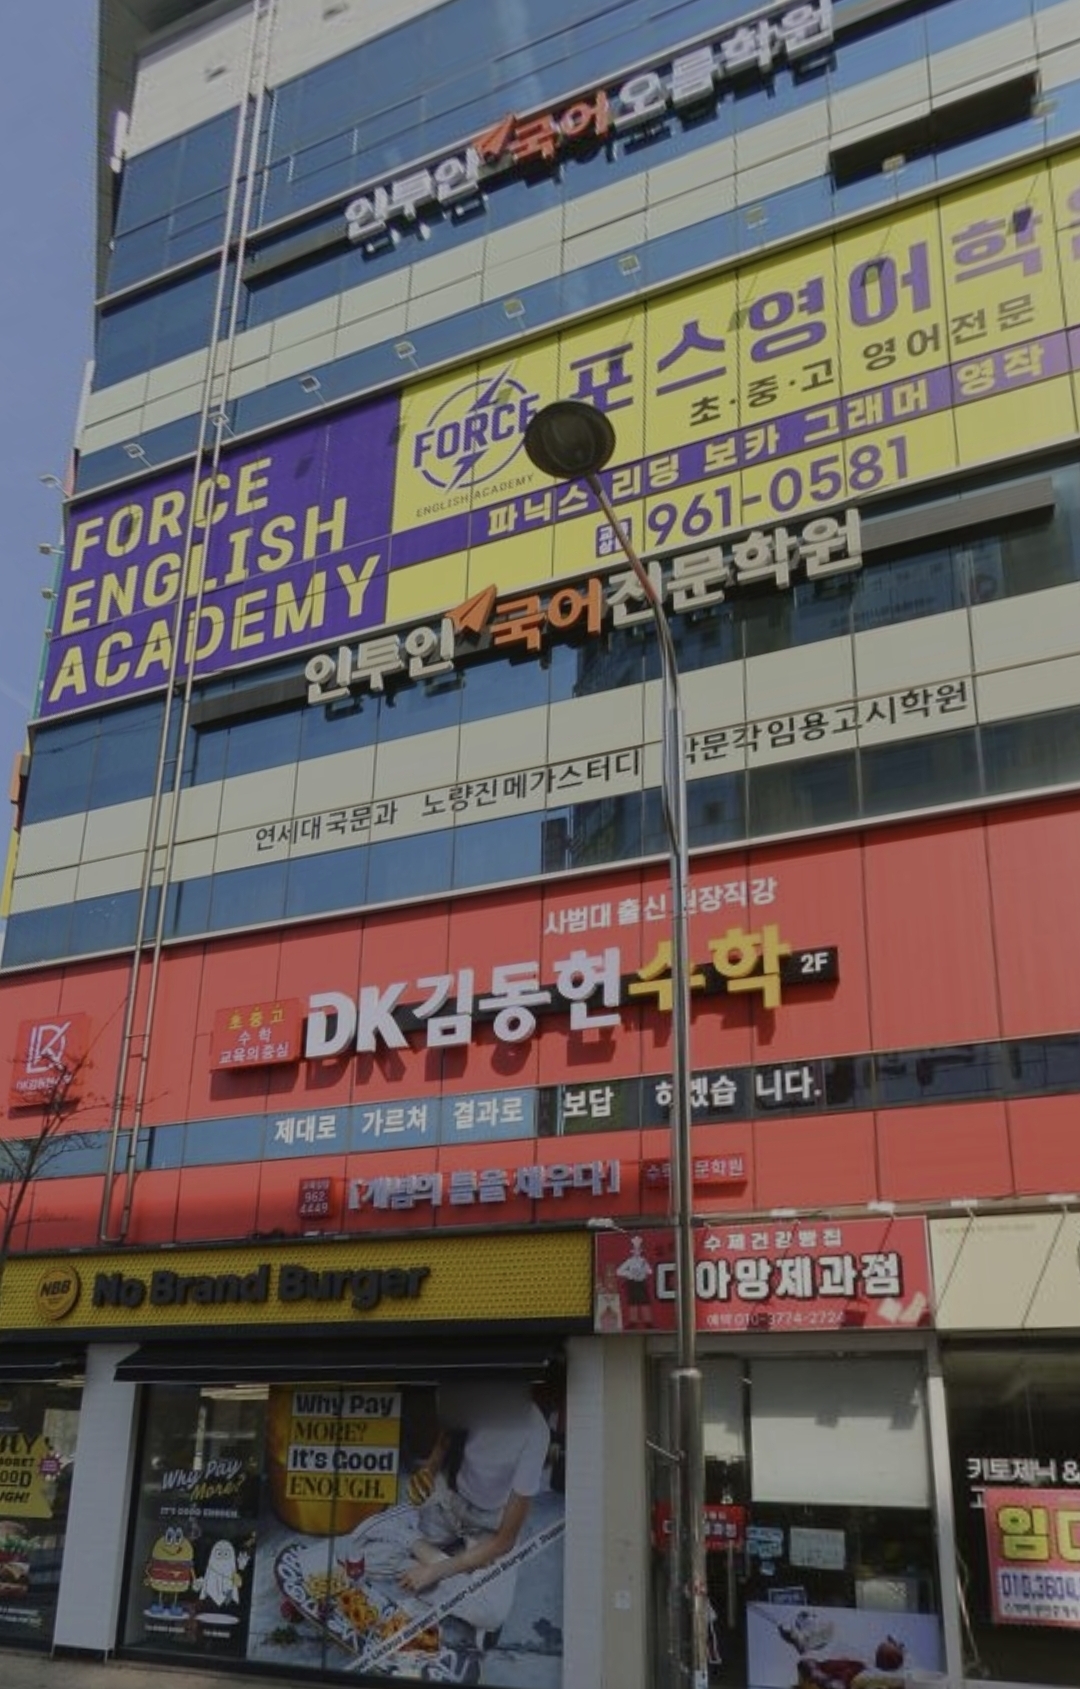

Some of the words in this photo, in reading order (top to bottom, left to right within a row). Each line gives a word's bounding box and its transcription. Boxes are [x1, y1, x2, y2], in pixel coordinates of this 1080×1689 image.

[569, 184, 1080, 413] 포스영어학
[413, 393, 540, 468] FORCE
[488, 484, 590, 537] 파닉스
[612, 453, 680, 501] 리딩
[704, 424, 780, 473] 보카
[804, 379, 930, 443] 그래머
[956, 343, 1046, 397] 영작
[70, 457, 272, 572] FORCE
[415, 496, 471, 517] ENGLISH
[472, 473, 534, 500] ACADEMY
[647, 435, 908, 547] 961-0581
[59, 497, 348, 636] ENGLISH
[48, 554, 381, 702] ACADEMY
[305, 618, 456, 705] 인투인
[544, 902, 612, 936] 사범대
[617, 893, 666, 926] 출신
[800, 951, 829, 974] 2F
[274, 1114, 337, 1144] 제대로
[453, 1096, 525, 1131] 결과로
[563, 1085, 614, 1118] 보답
[755, 1066, 823, 1102] 니다.
[40, 1279, 72, 1298] NBB
[92, 1270, 147, 1309] No
[150, 1263, 271, 1306] Brand
[278, 1264, 431, 1312] Burger
[296, 1393, 345, 1416] Why
[350, 1394, 394, 1416] Pay
[294, 1421, 368, 1443] MORE?
[162, 1468, 203, 1491] Why
[204, 1458, 243, 1480] Pay
[292, 1450, 328, 1469] It's
[331, 1451, 394, 1471] Good
[289, 1476, 386, 1499] ENOUGH.
